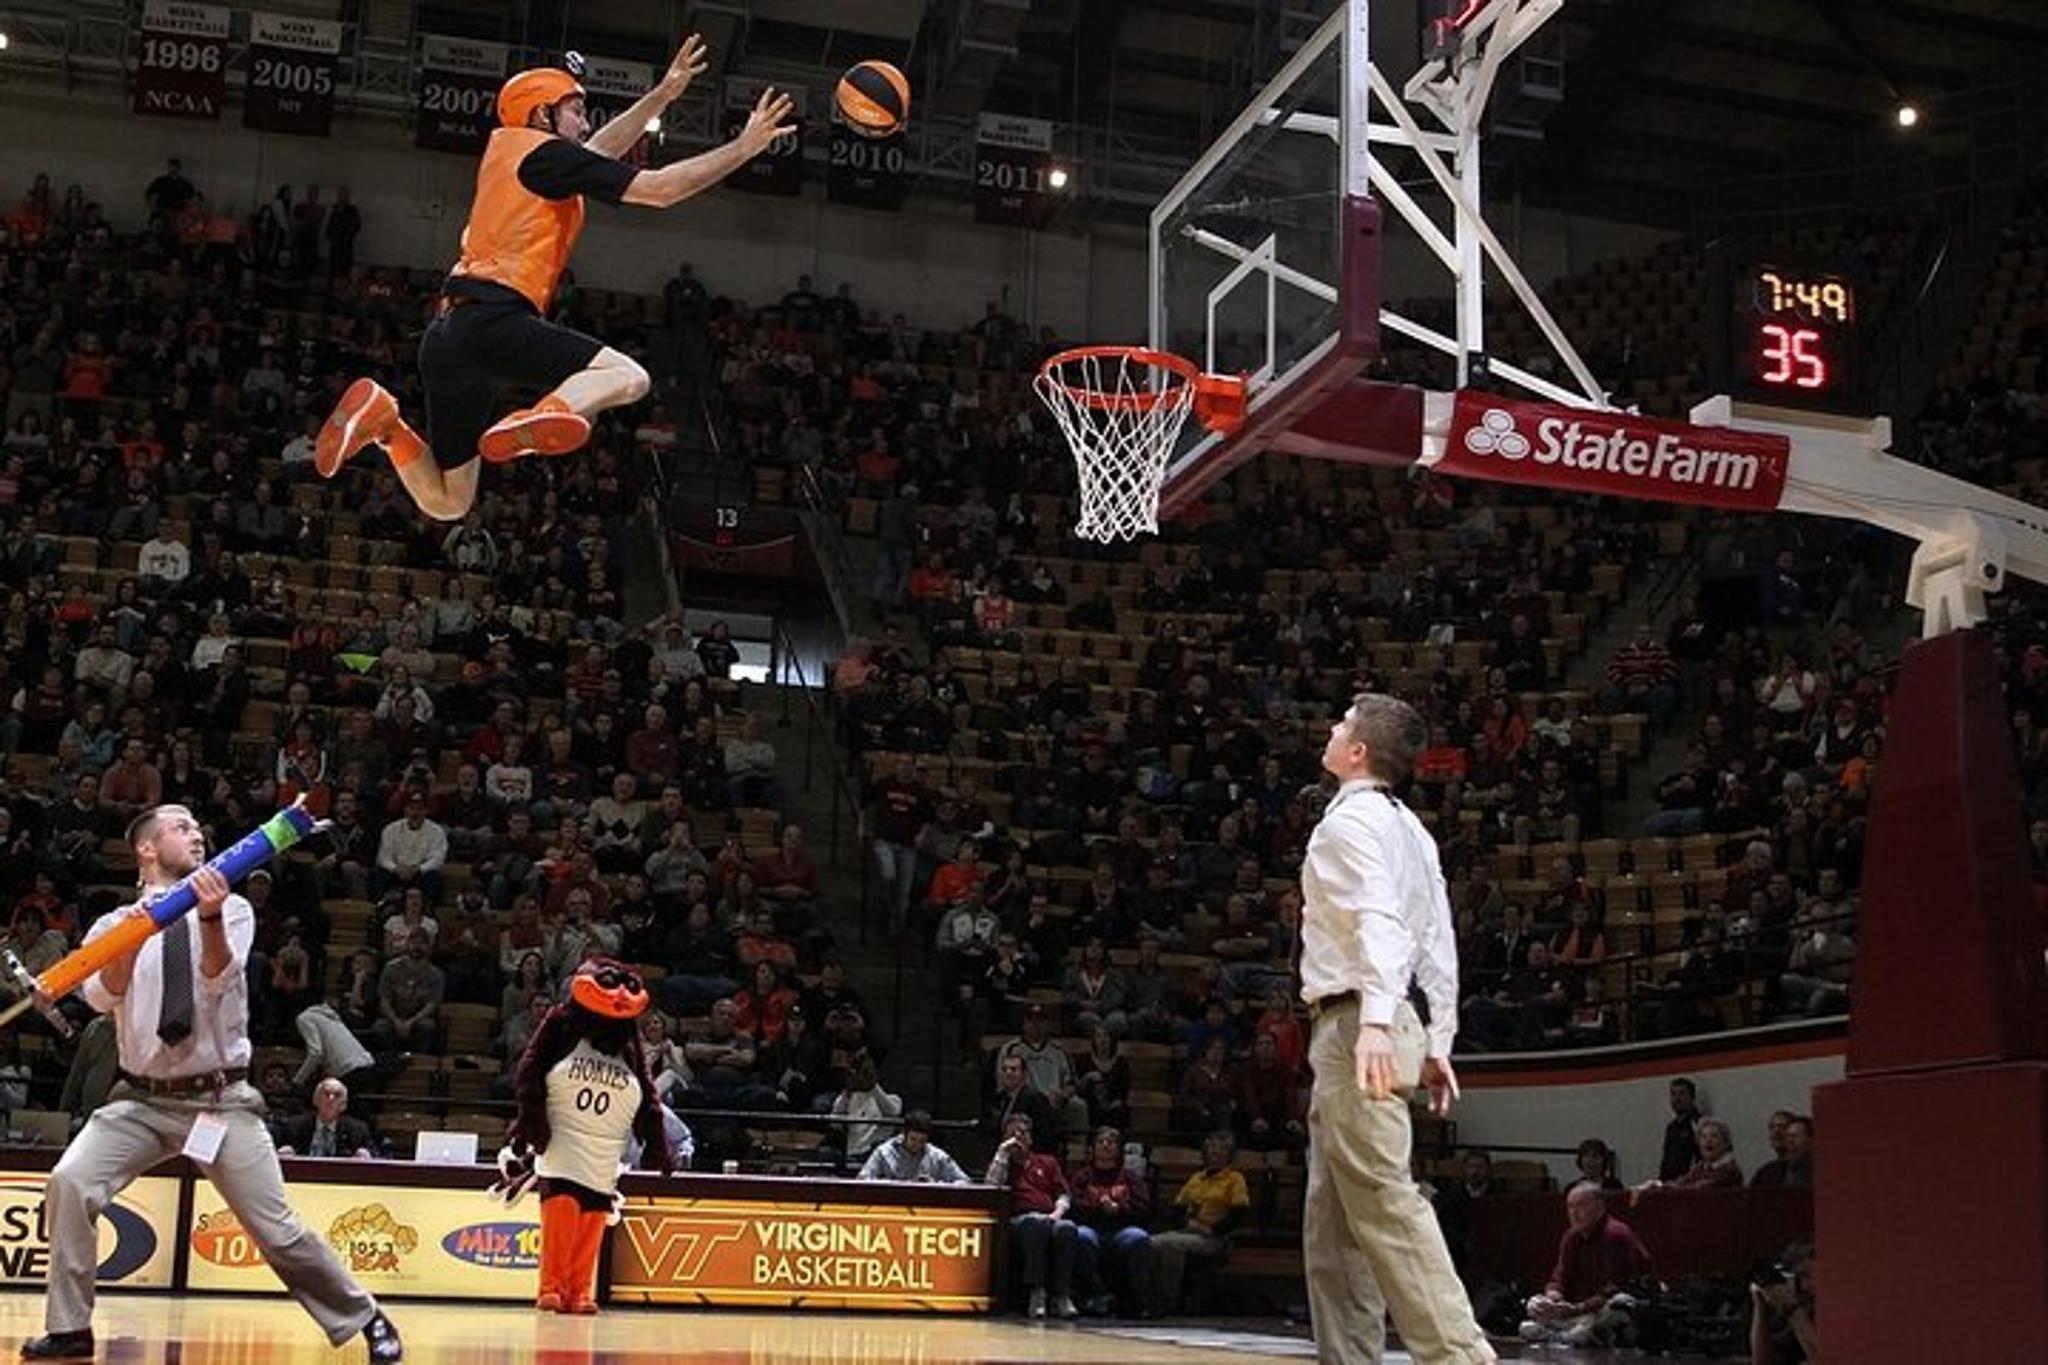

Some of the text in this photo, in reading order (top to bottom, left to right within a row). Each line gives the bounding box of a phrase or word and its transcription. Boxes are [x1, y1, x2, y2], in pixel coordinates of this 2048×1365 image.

[142, 39, 221, 73] 1996
[253, 59, 332, 95] 2005
[144, 90, 214, 115] NCAA
[423, 83, 497, 117] 2007
[832, 139, 903, 175] 2010
[977, 160, 1046, 194] 2011
[1761, 273, 1847, 321] 7:49
[1762, 325, 1824, 388] 35
[716, 508, 738, 527] 13
[568, 1057, 629, 1090] HOKIES
[576, 1087, 610, 1115] 00
[454, 1226, 512, 1254] Mix
[755, 1221, 981, 1258] VIRGINIA TECH
[755, 1256, 934, 1290] BASKETBALL
